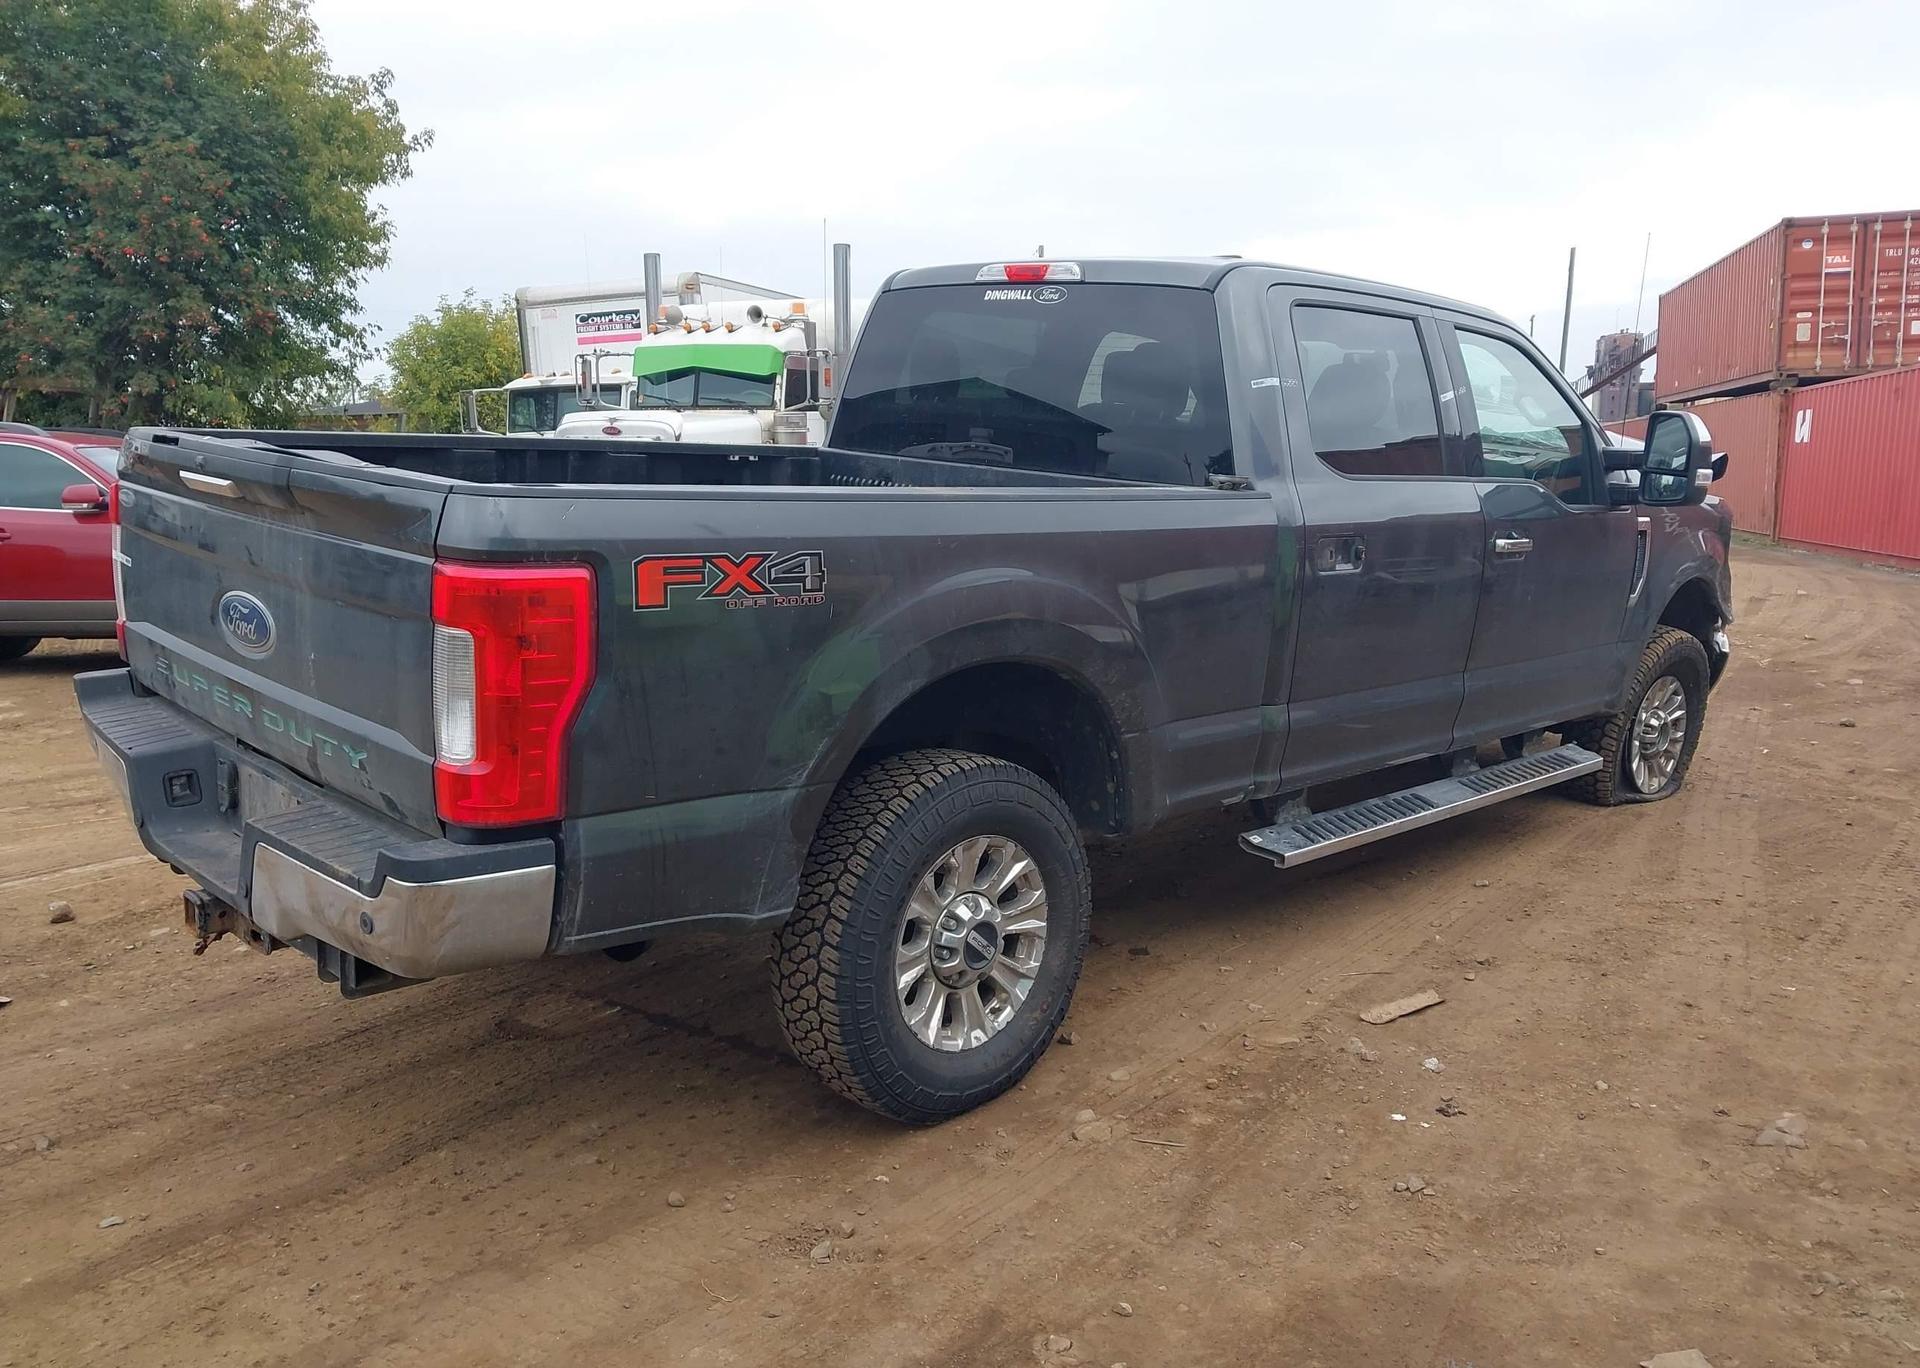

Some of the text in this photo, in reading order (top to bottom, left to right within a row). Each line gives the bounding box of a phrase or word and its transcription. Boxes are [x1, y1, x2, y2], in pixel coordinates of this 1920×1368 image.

[1826, 255, 1851, 264] TAL
[984, 289, 1032, 301] DINGWALL
[576, 312, 640, 325] Courtesy
[577, 324, 599, 333] FREIGHT
[599, 323, 624, 332] SYSTEMS
[632, 550, 827, 612] FX4
[725, 594, 826, 610] OFF ROAD
[227, 602, 257, 640] Ford
[155, 655, 368, 769] SUPER DUTY
[971, 936, 992, 955] FORD
